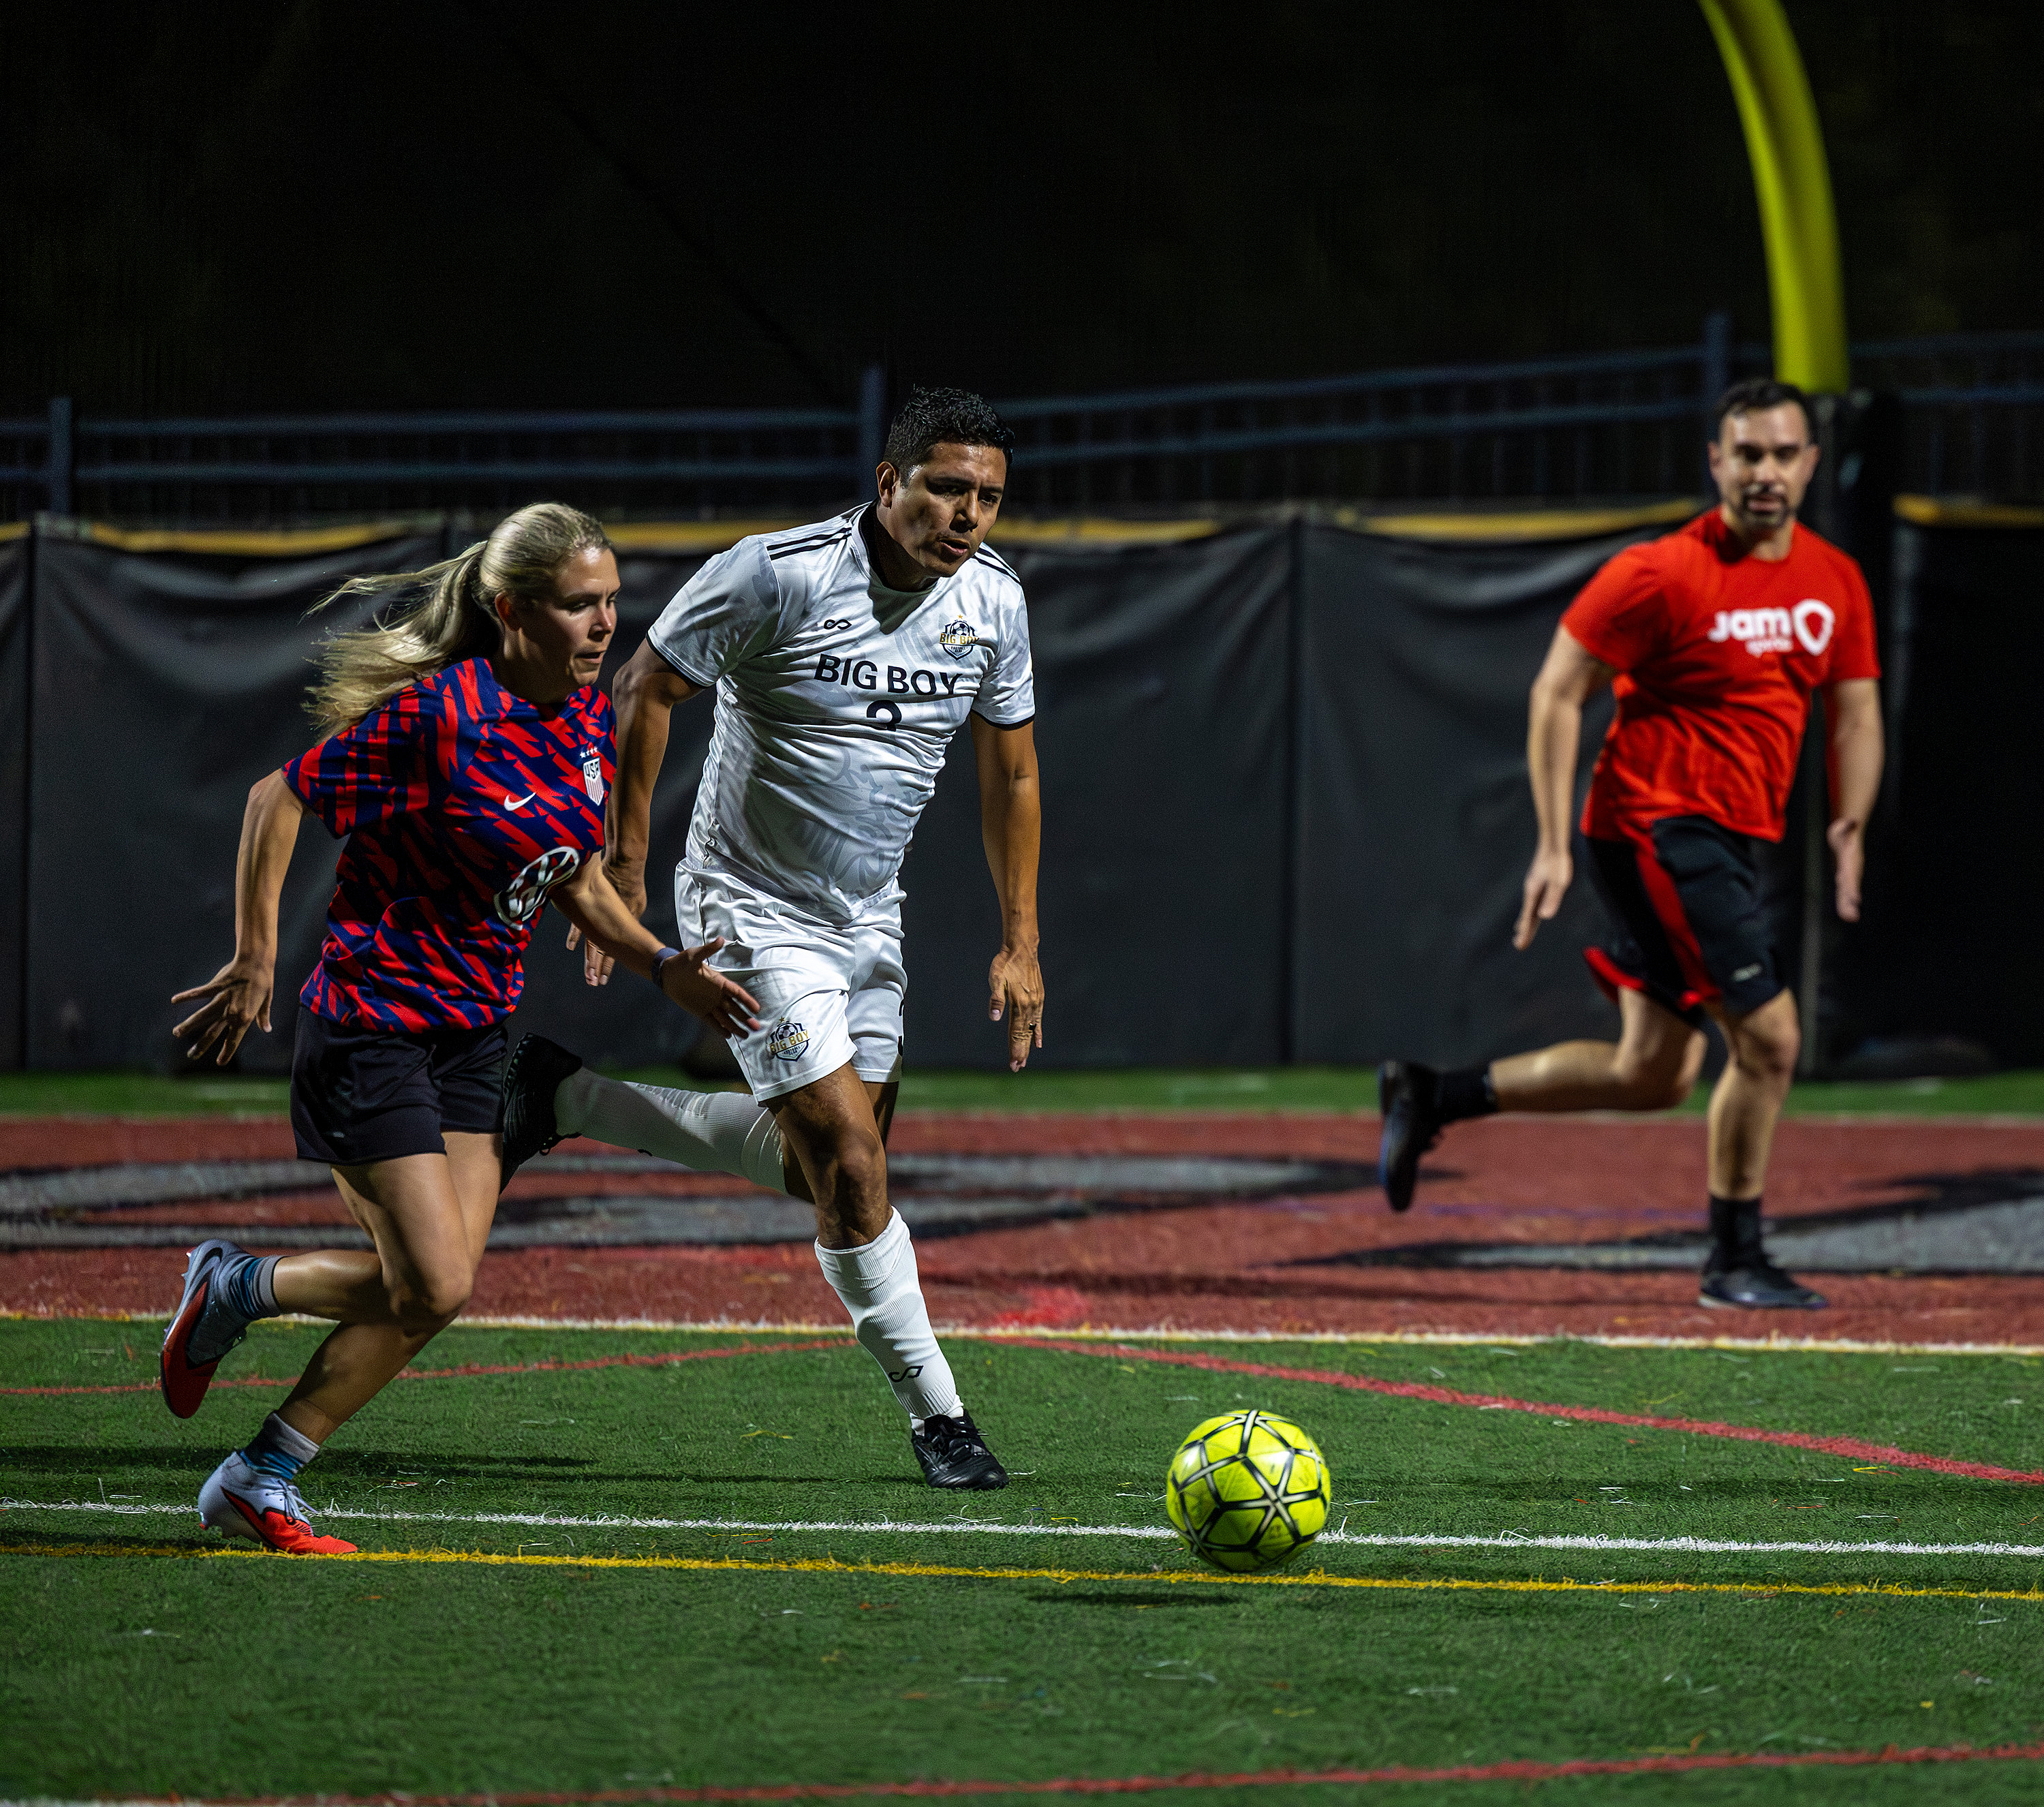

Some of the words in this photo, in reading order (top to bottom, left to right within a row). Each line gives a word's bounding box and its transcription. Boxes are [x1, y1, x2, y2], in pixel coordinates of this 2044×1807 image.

[940, 633, 956, 644] BIG
[814, 653, 878, 690] BIG
[887, 665, 963, 696] BOY
[769, 1040, 787, 1053] BIG
[788, 1030, 809, 1045] BOY
